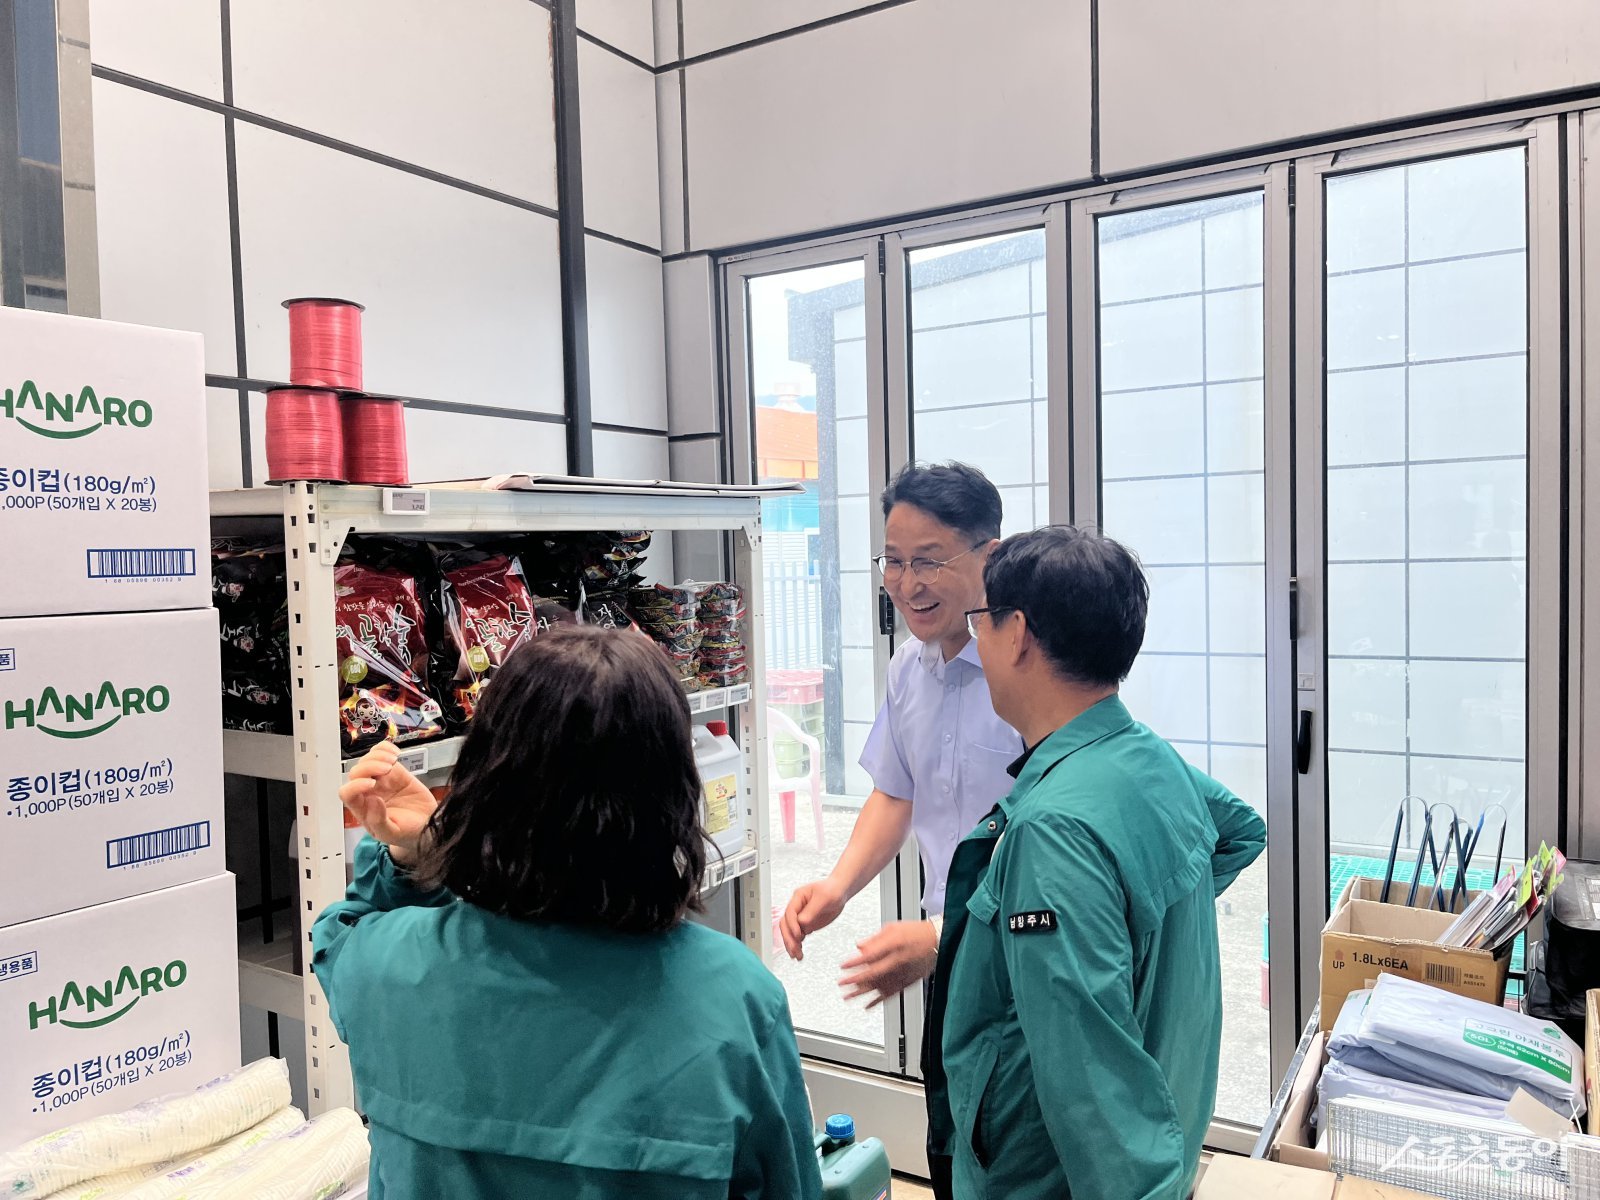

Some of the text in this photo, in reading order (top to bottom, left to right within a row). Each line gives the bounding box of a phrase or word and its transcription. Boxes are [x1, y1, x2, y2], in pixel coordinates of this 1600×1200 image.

[105, 497, 116, 510] X
[121, 497, 157, 513] 20봉)
[4, 680, 171, 730] HANARO
[125, 786, 135, 800] X
[139, 778, 175, 797] 20봉)
[1009, 912, 1050, 930] 남양주시
[1332, 960, 1345, 970] UP
[1352, 951, 1409, 971] 1.8Lx6EA
[28, 959, 188, 1031] HANARO
[144, 1063, 154, 1077] X
[158, 1049, 192, 1072] 20봉)
